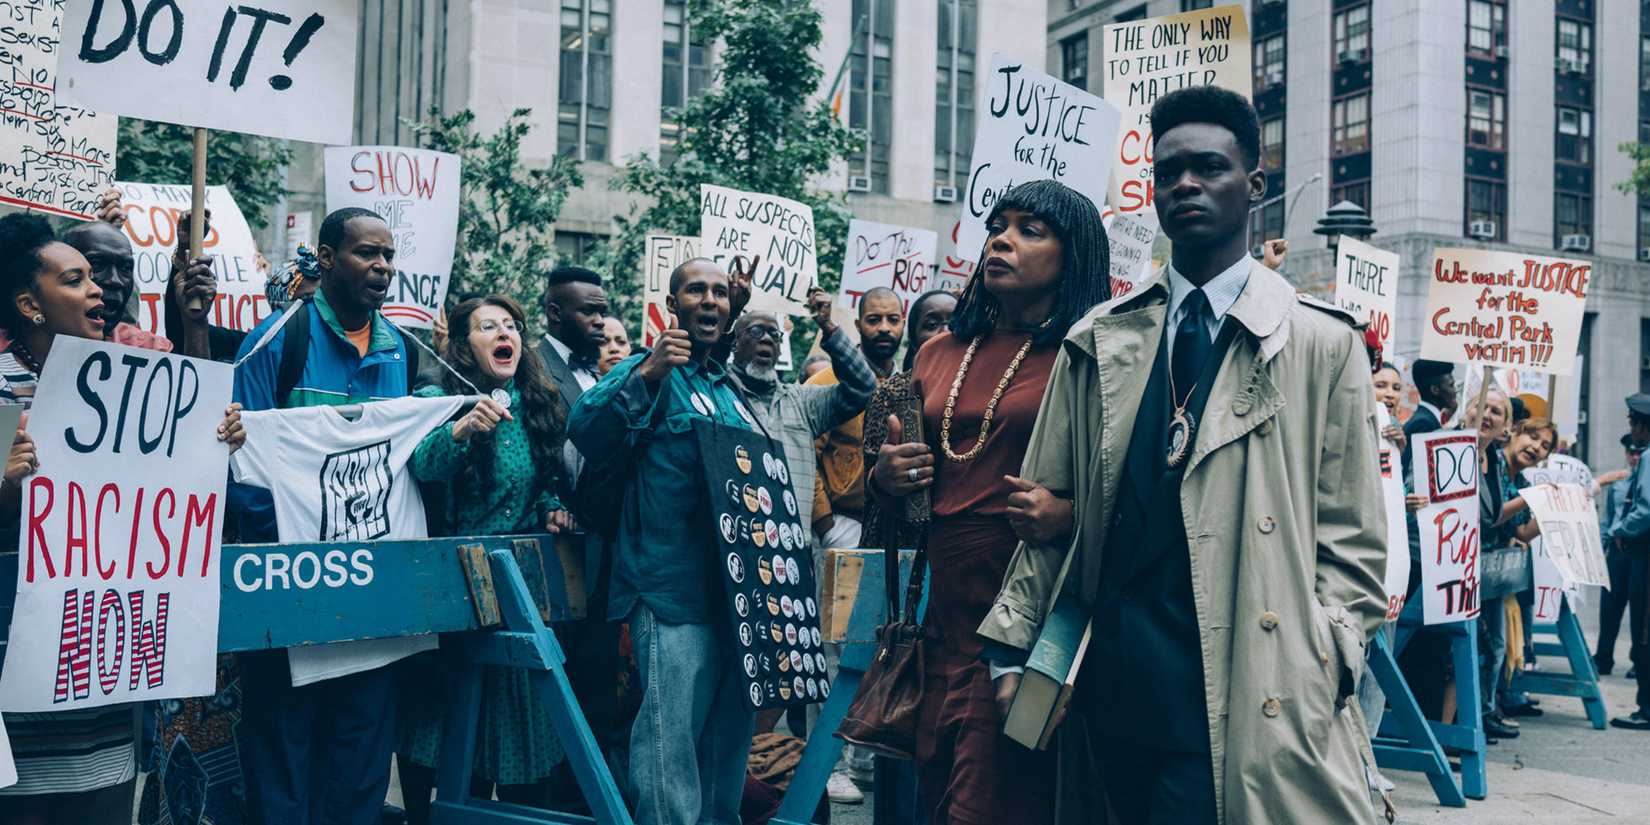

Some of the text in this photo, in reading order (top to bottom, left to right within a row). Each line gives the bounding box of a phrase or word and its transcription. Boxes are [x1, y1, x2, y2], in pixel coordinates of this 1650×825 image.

[78, 0, 325, 92] DO IT!
[1113, 15, 1232, 53] THE ONLY WAY
[1108, 43, 1229, 80] TO TELL IF YOU
[349, 150, 439, 200] SHOW
[1041, 143, 1067, 180] the
[701, 191, 813, 248] ALL SUSPECTS
[716, 226, 812, 271] ARE NOT
[1345, 254, 1389, 297] THERE
[1435, 258, 1592, 298] We want JUSTICE
[1476, 286, 1539, 315] for the
[1432, 307, 1554, 344] Central Park
[64, 350, 199, 458] STOP
[1435, 445, 1476, 494] DO
[25, 476, 217, 584] RACISM
[233, 549, 374, 592] CROSS
[53, 588, 170, 704] NOW
